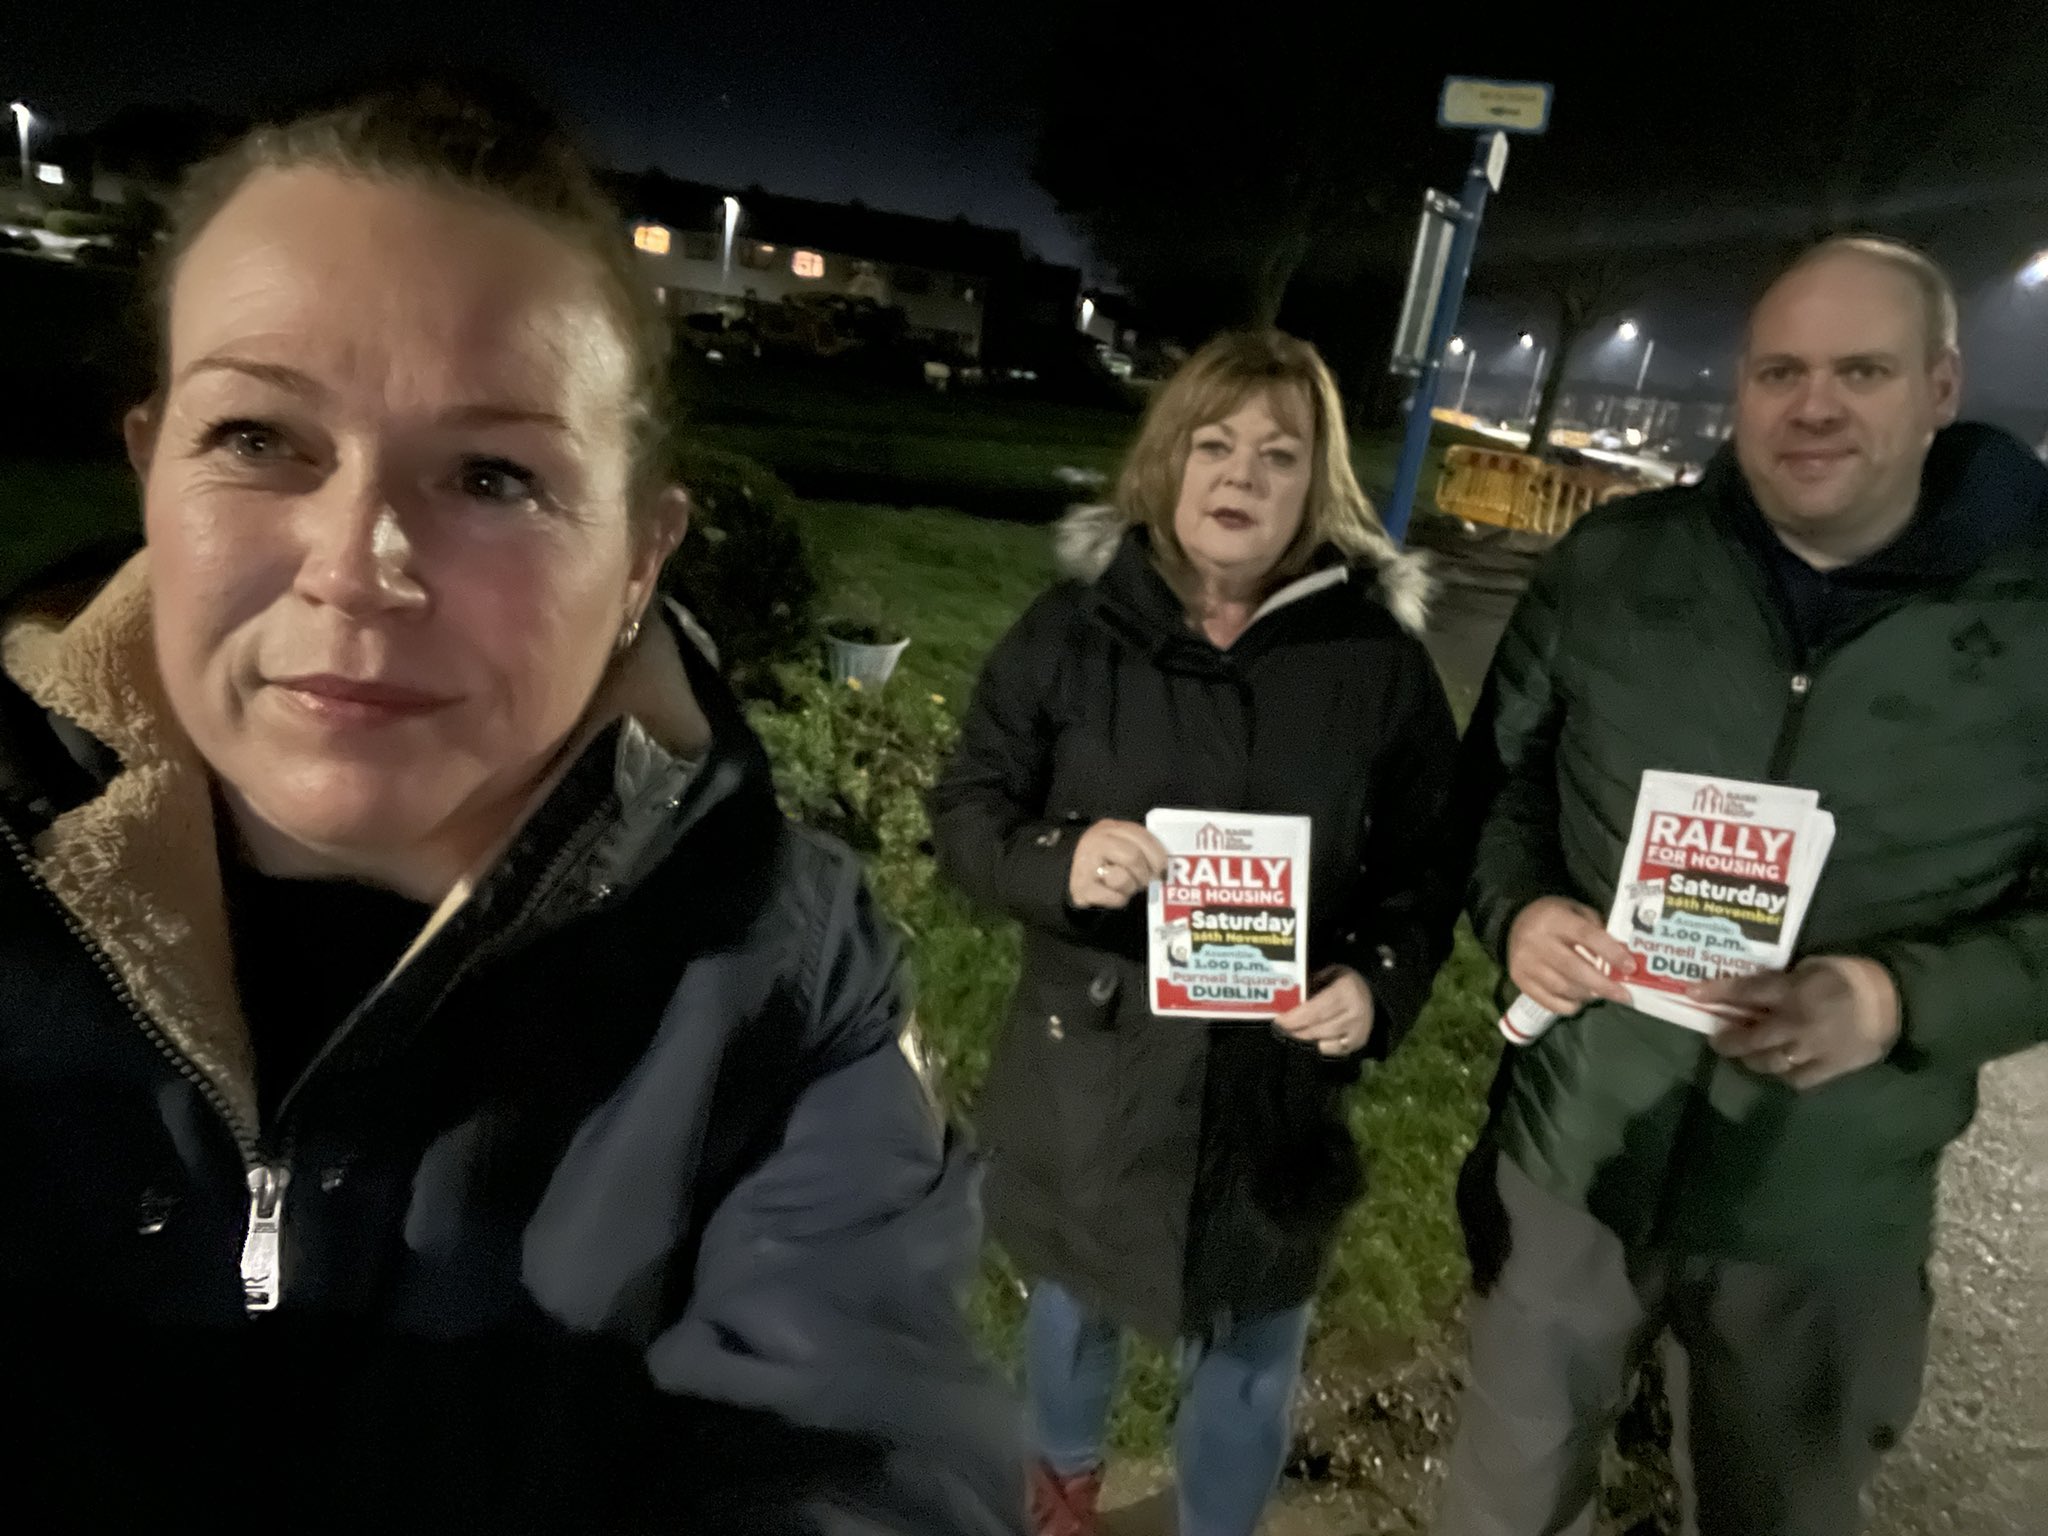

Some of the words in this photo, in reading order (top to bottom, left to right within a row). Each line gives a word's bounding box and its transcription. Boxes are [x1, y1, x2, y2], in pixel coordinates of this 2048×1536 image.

[1650, 815, 1790, 863] RALLY
[1167, 857, 1288, 889] RALLY
[1647, 846, 1687, 863] FOR
[1691, 851, 1781, 881] HOUSING
[1167, 886, 1201, 900] FOR
[1205, 888, 1286, 904] HOUSING
[1668, 873, 1788, 915] Saturday
[1191, 910, 1297, 936] Saturday
[1661, 927, 1701, 943] 1.00
[1633, 937, 1695, 959] Parnell
[1194, 958, 1229, 970] 1.00
[1233, 960, 1271, 972] p.m.
[1173, 971, 1227, 984] Parnell
[1233, 973, 1290, 987] Square
[1192, 985, 1269, 1000] DUBLIN
